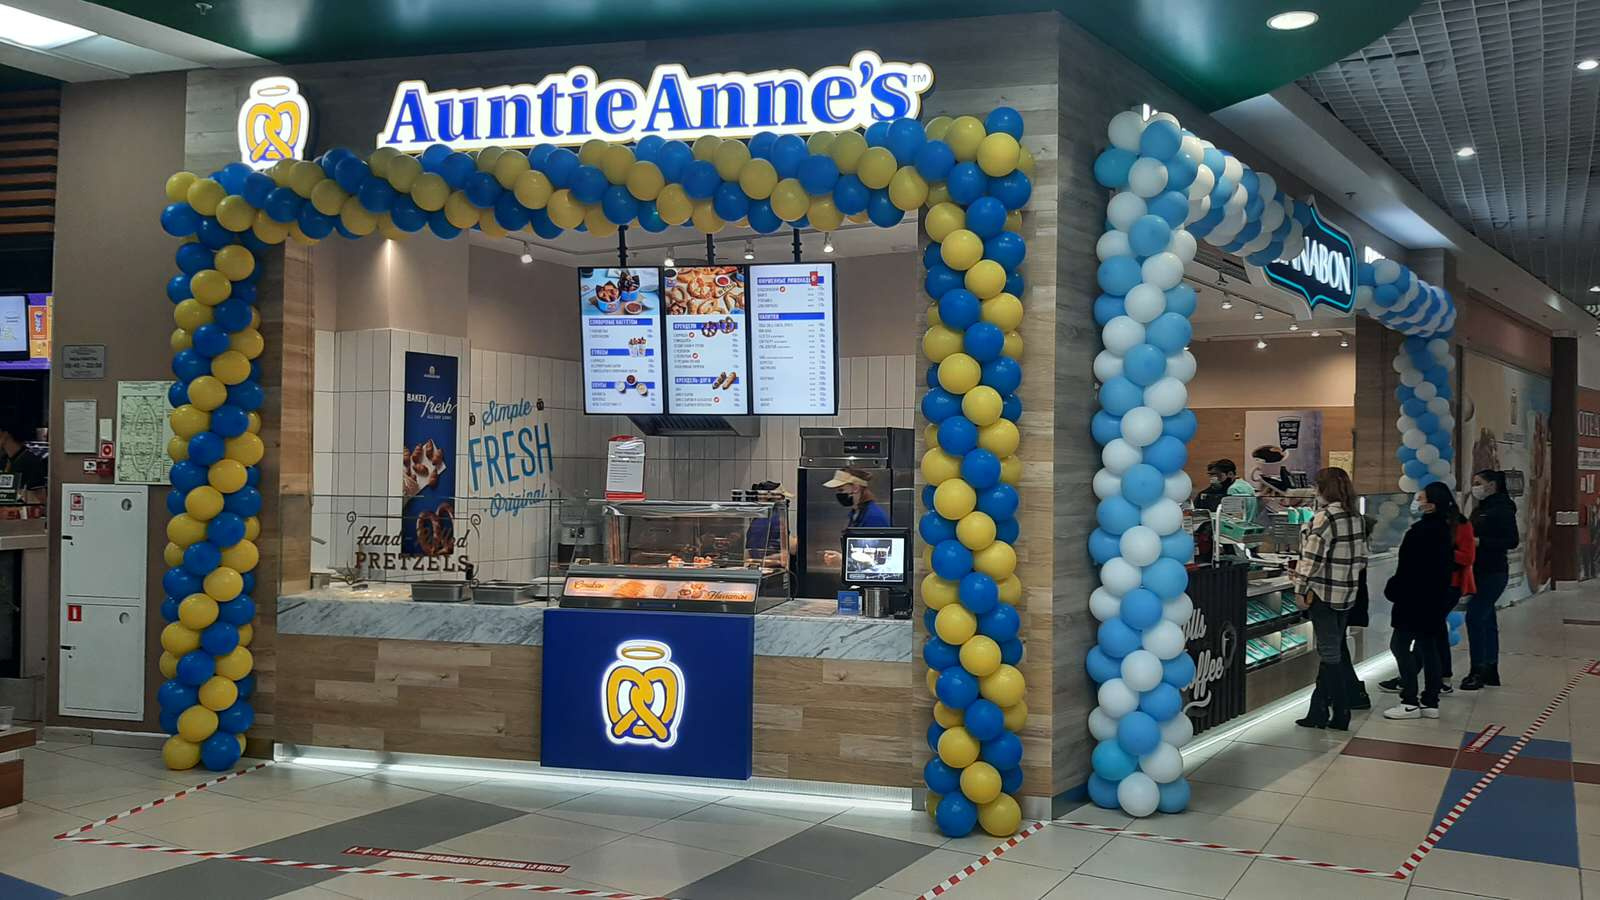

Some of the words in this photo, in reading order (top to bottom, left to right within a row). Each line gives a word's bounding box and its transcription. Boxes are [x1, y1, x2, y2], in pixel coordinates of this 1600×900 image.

[1272, 236, 1351, 295] NABON
[407, 393, 427, 403] BAKED
[420, 396, 459, 418] fresh
[482, 398, 532, 430] Simple
[468, 422, 553, 492] FRESH
[490, 483, 547, 518] Original
[357, 525, 470, 549] Hand-Rlled
[354, 551, 469, 572] PRETZELS
[1182, 608, 1207, 641] olls
[1181, 649, 1224, 700] ffee
